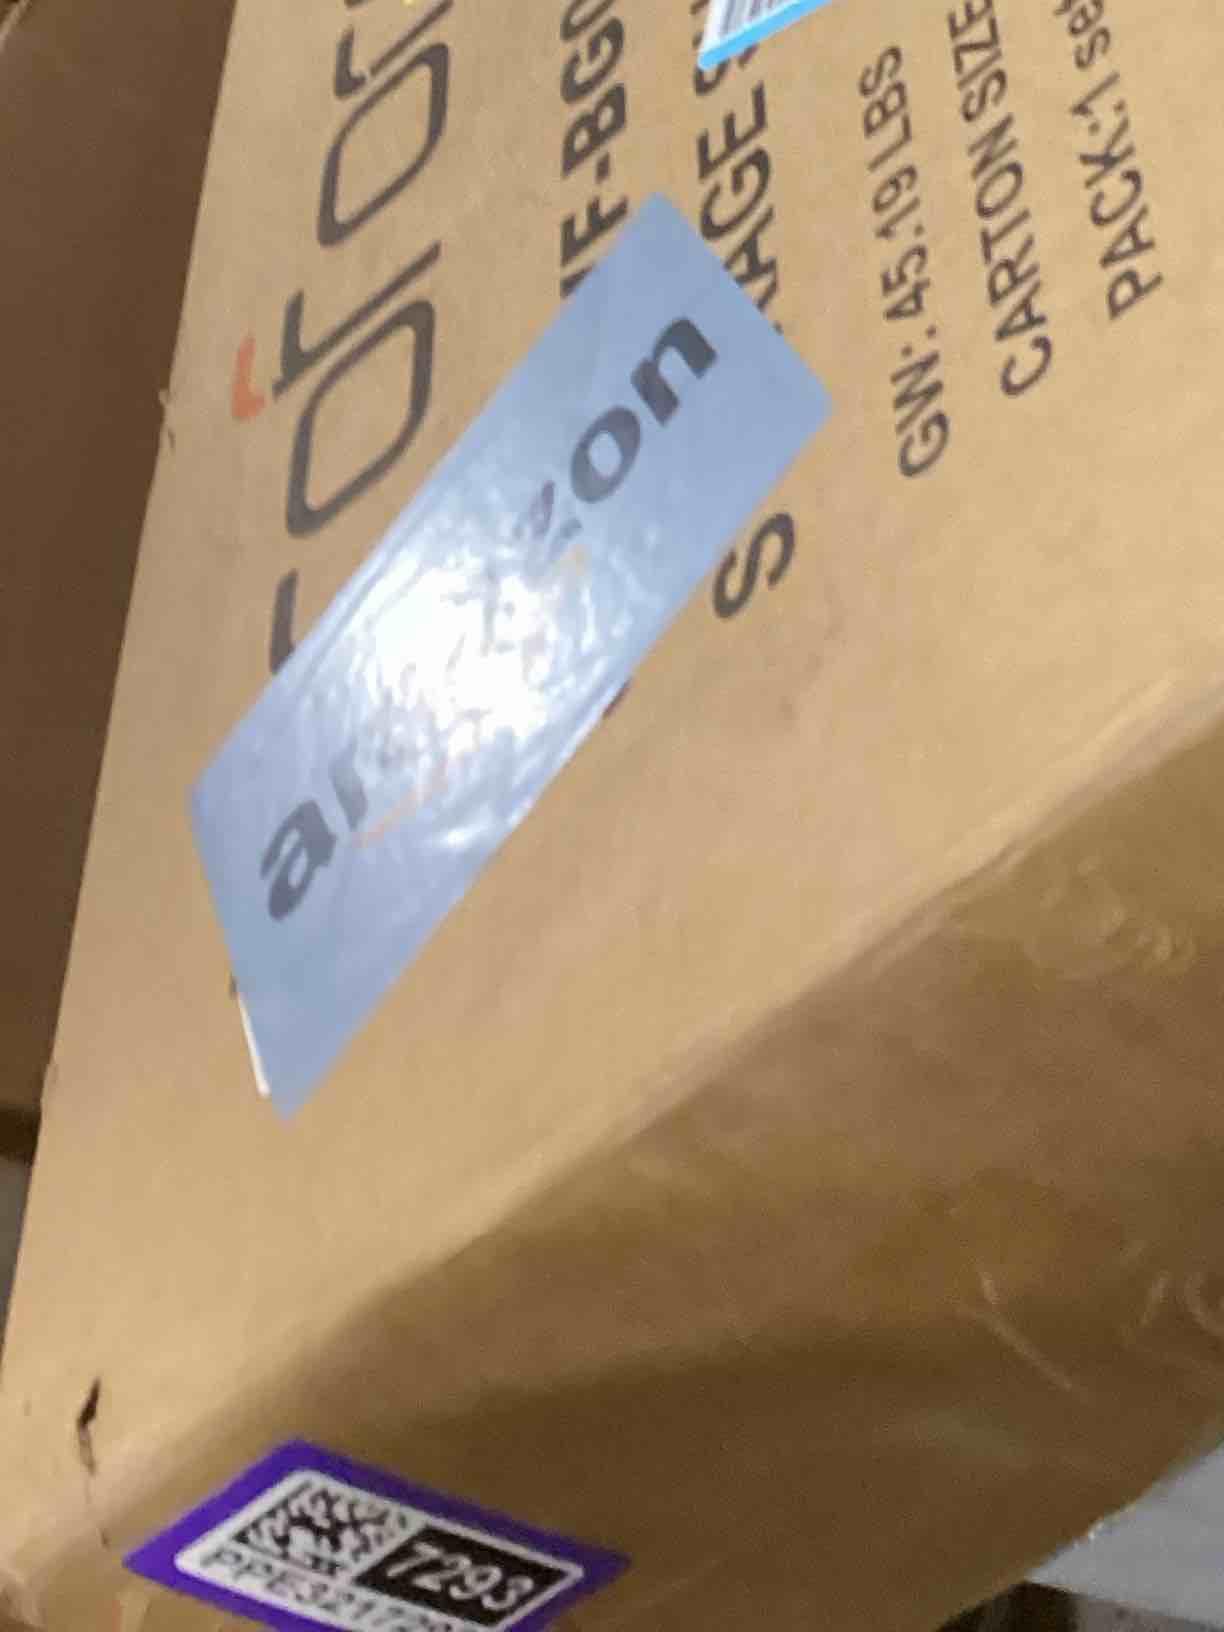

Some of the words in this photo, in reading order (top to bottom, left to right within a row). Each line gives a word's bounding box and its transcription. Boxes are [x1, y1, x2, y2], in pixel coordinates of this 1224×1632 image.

[858, 44, 913, 172] LBS
[870, 163, 932, 322] 45.19
[967, 112, 1053, 399] CARTON
[890, 325, 950, 479] GW:
